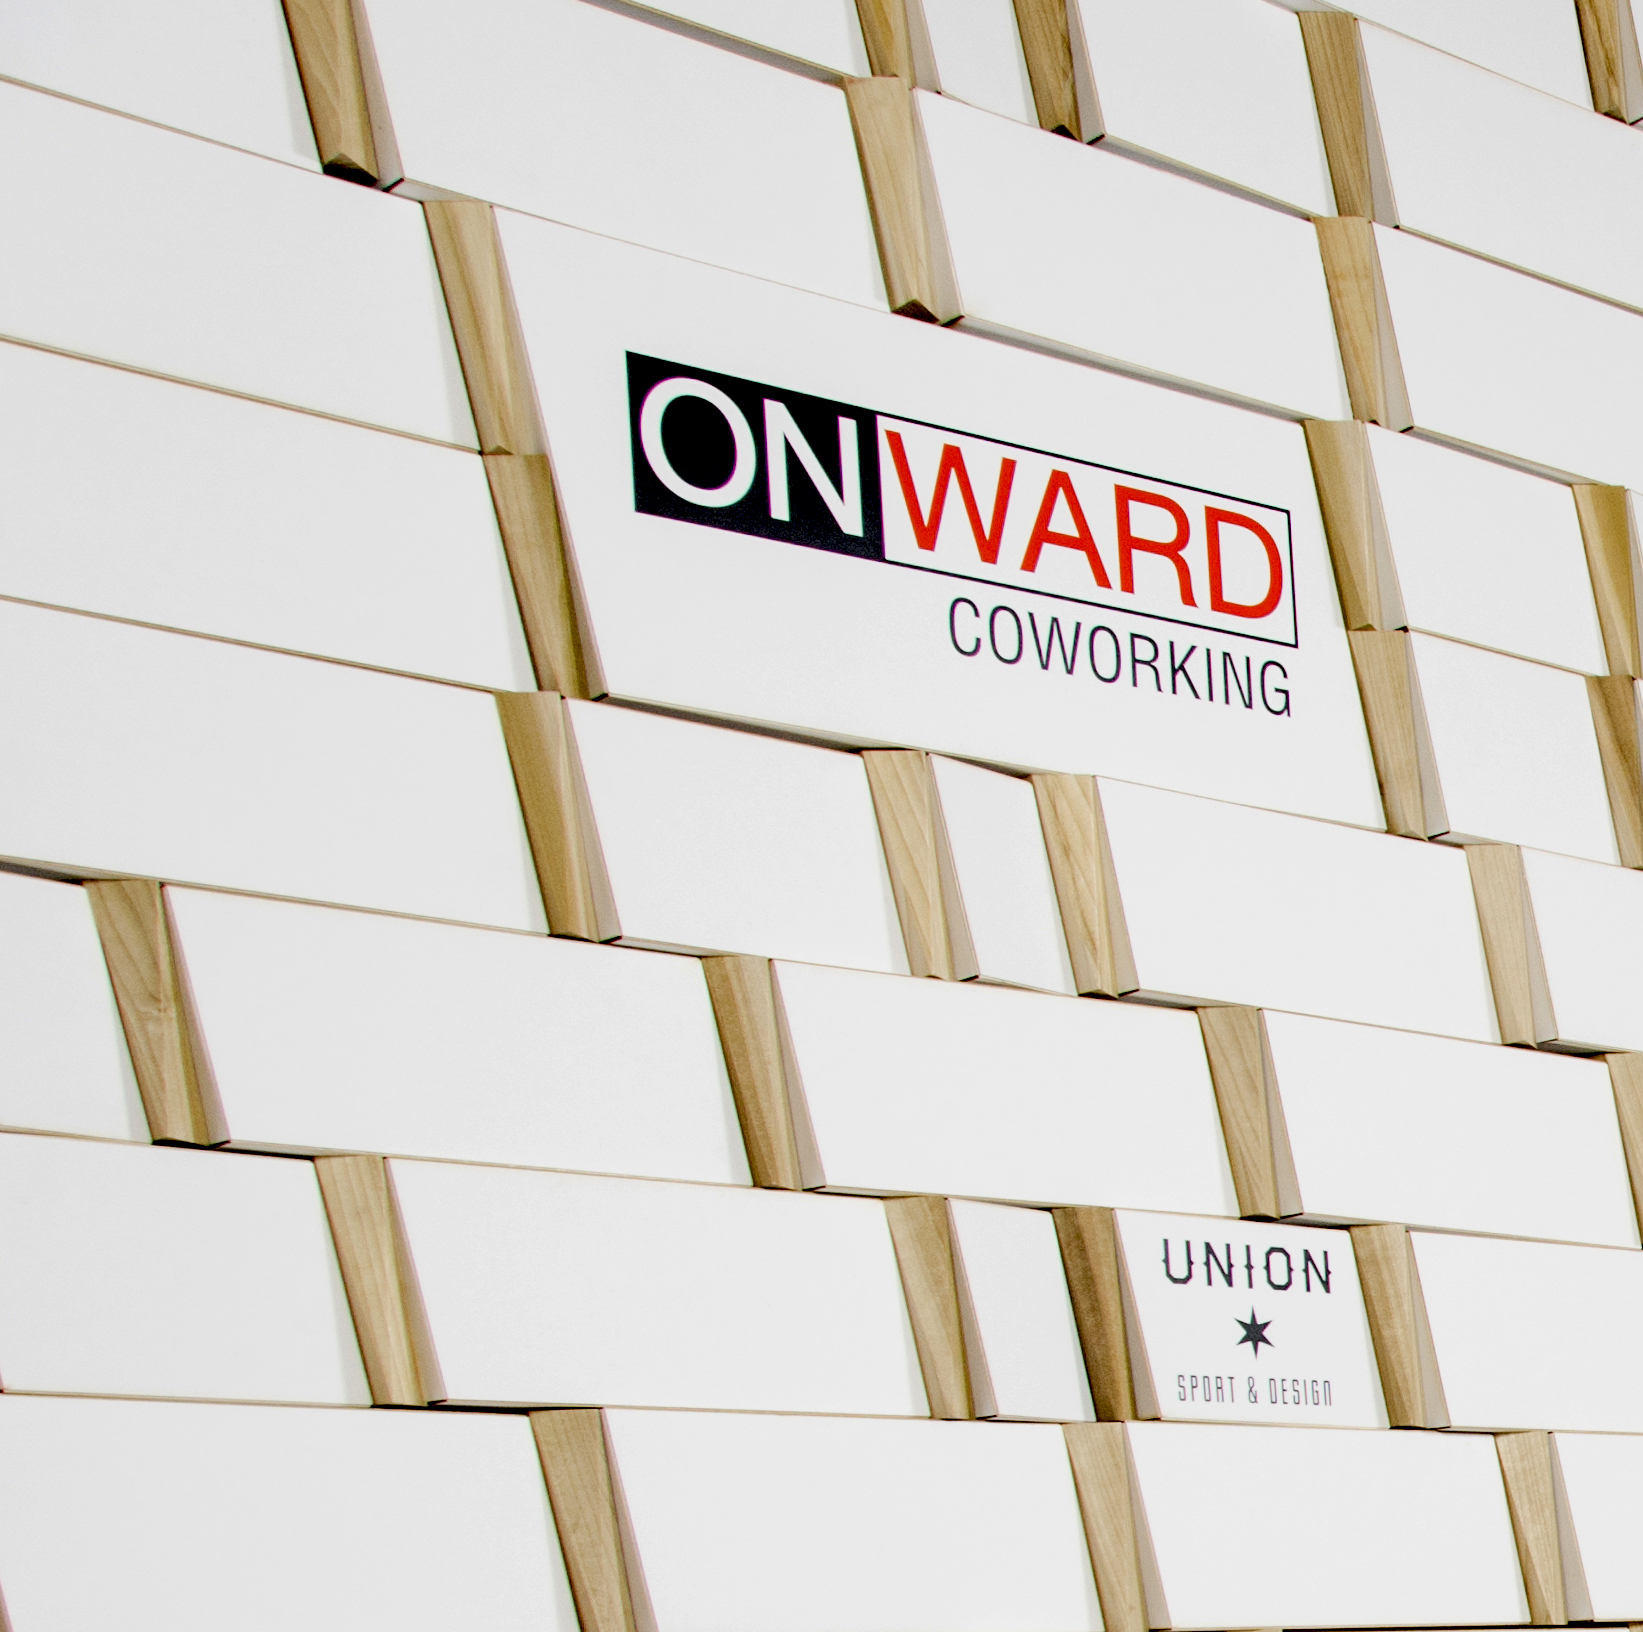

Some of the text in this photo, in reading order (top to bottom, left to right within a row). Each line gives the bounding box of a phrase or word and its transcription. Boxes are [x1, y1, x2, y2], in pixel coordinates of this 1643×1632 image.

[640, 376, 1285, 620] ONWARD
[947, 596, 1293, 718] COWORKING
[1161, 1237, 1333, 1295] UNION
[1177, 1374, 1332, 1407] SPORT & DESIGN
